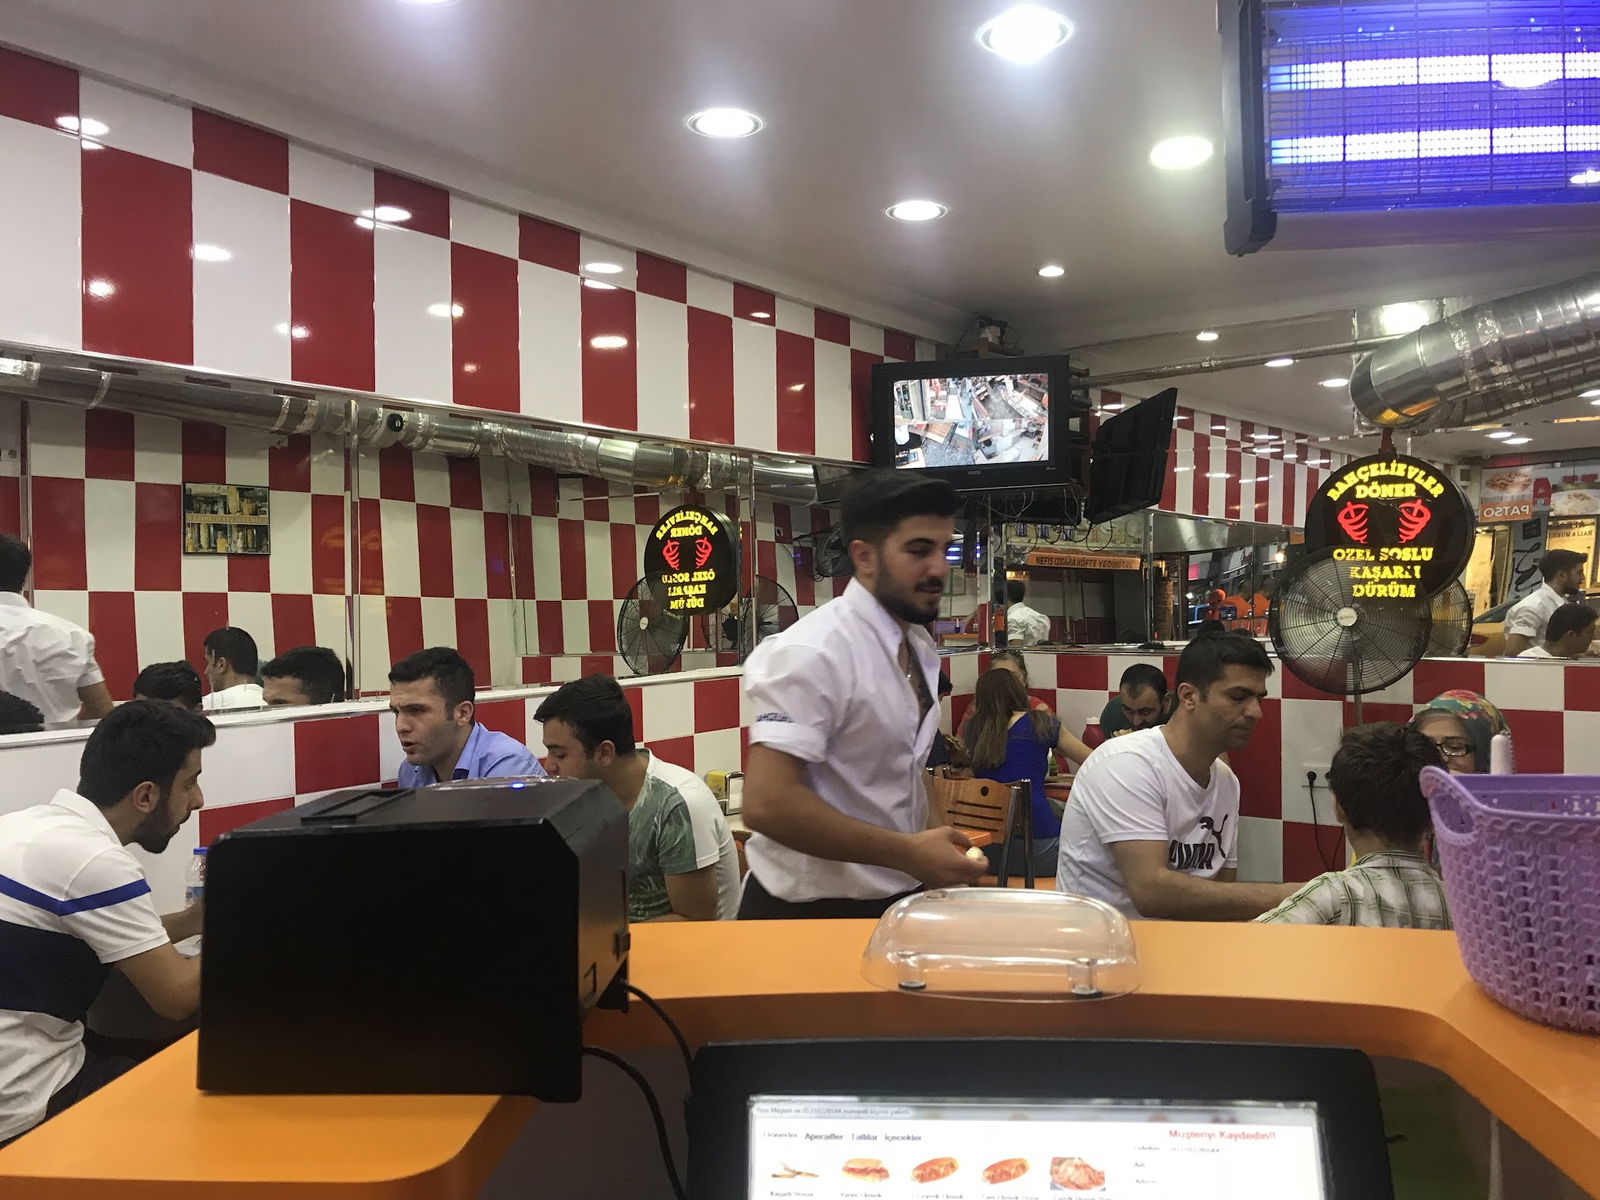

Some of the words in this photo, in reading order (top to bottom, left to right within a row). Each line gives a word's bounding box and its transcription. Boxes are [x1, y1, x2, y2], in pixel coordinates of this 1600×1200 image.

[1326, 459, 1446, 502] BAHÇELİEVLER
[1355, 481, 1417, 499] DÖNER
[1379, 546, 1434, 561] SOSLU
[1352, 581, 1417, 598] DÜRÜM
